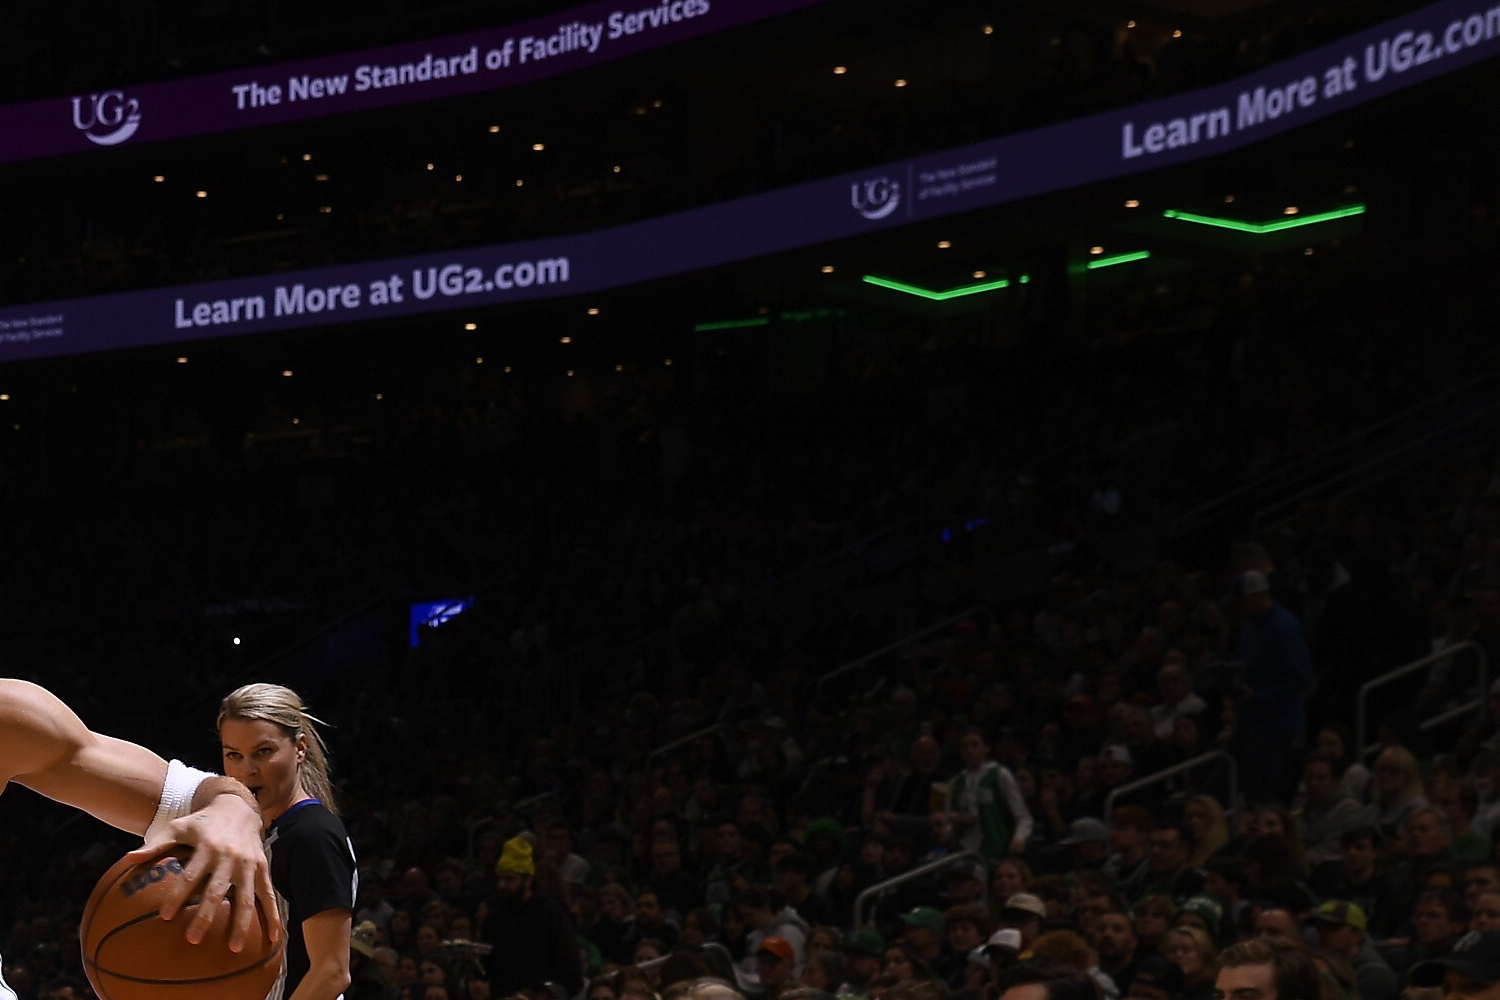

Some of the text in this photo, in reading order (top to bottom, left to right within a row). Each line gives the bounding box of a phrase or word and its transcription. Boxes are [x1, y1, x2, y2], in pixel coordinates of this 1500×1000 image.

[232, 0, 711, 110] The New Standard of Facility Services
[72, 90, 141, 130] UG2
[1122, 106, 1231, 159] Learn
[1236, 76, 1318, 131] More
[1323, 56, 1358, 98] at
[173, 256, 571, 330] Learn More at UG2.com
